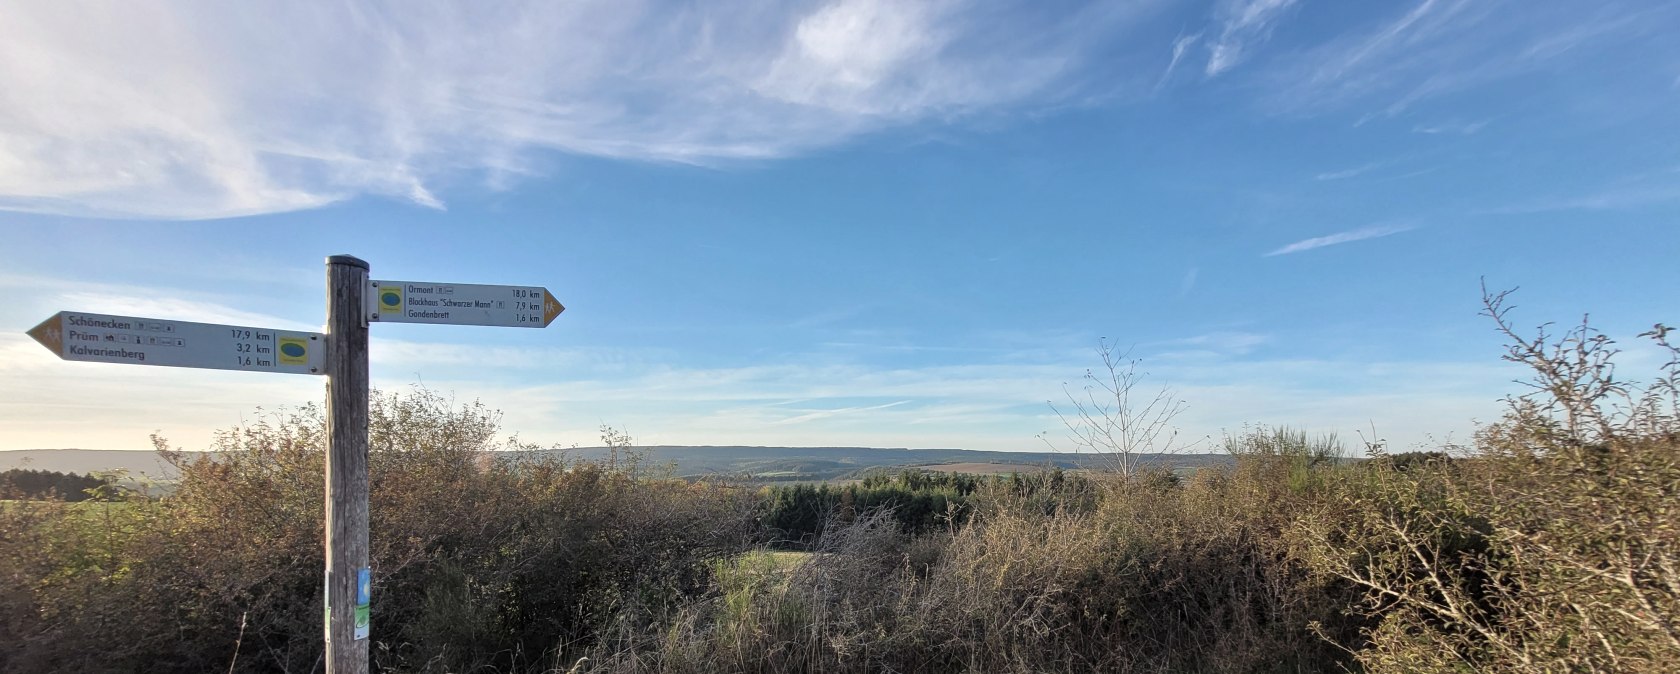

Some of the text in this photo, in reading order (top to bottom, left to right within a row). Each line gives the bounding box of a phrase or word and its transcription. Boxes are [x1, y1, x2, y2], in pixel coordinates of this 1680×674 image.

[408, 285, 434, 294] Ormont
[512, 289, 540, 298] 18,0 km
[516, 302, 540, 311] 7,9 km
[68, 316, 131, 330] Schönecken
[516, 314, 540, 322] 1,6 km
[69, 330, 99, 342] Prüm
[231, 329, 251, 341] 17,9
[256, 331, 270, 341] km
[69, 346, 145, 360] Kalvarienberg
[237, 343, 270, 354] 3,2 km
[238, 356, 270, 366] 1,6 km
